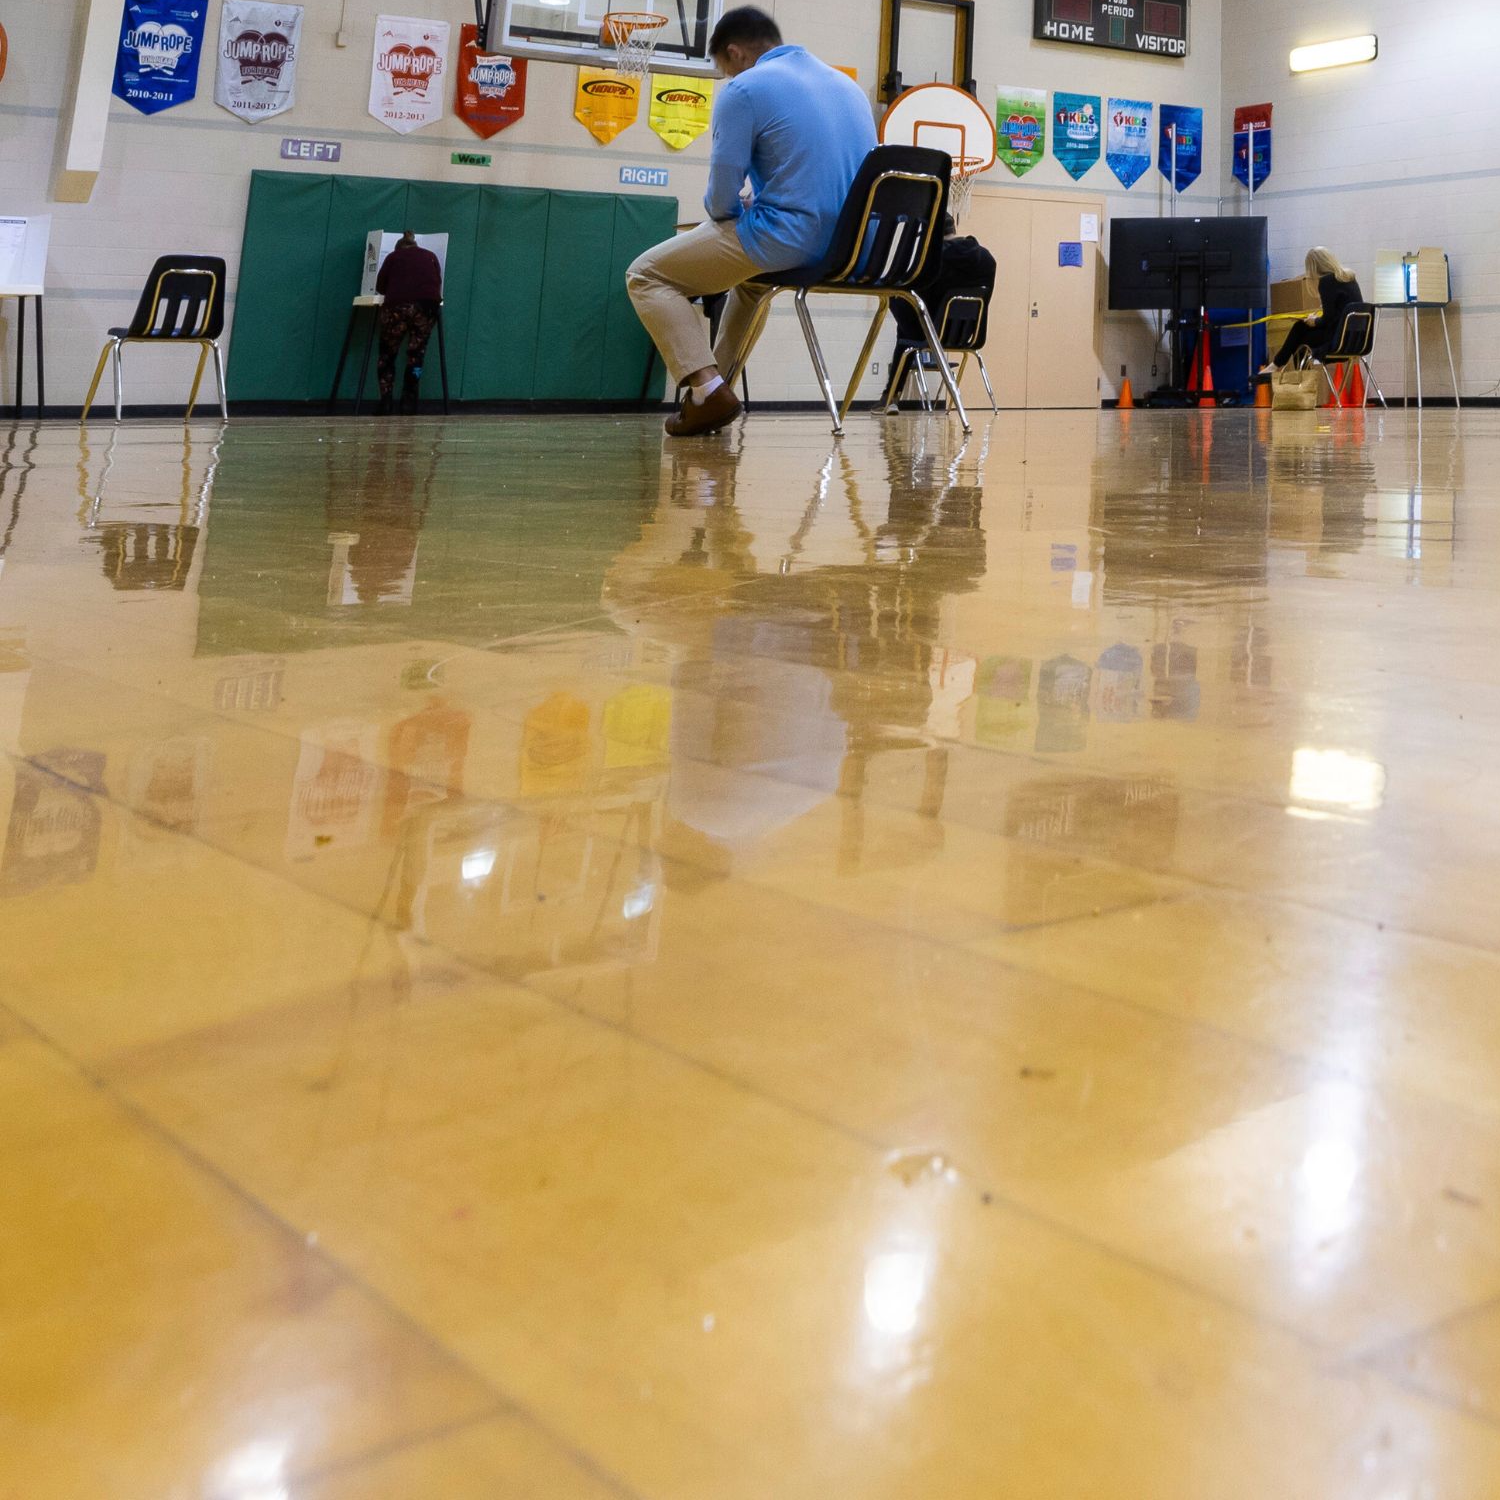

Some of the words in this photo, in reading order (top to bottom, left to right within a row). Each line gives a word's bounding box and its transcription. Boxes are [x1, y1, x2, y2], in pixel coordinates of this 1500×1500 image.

[1101, 5, 1134, 18] PERIOD
[1046, 21, 1095, 41] HOME
[123, 30, 160, 52] JUMP
[161, 34, 193, 53] ROPE
[1136, 34, 1186, 54] VISITOR
[223, 40, 260, 61] JUMP
[261, 42, 295, 62] ROPE
[377, 53, 412, 73] JUMP
[413, 55, 443, 75] ROPE
[126, 89, 173, 101] 2010-2011
[232, 100, 277, 110] 2011-2012
[384, 110, 425, 121] 2012-2013
[1069, 112, 1095, 124] KIDS
[287, 141, 337, 160] LEFT
[458, 154, 487, 164] West
[622, 168, 667, 185] RIGHT
